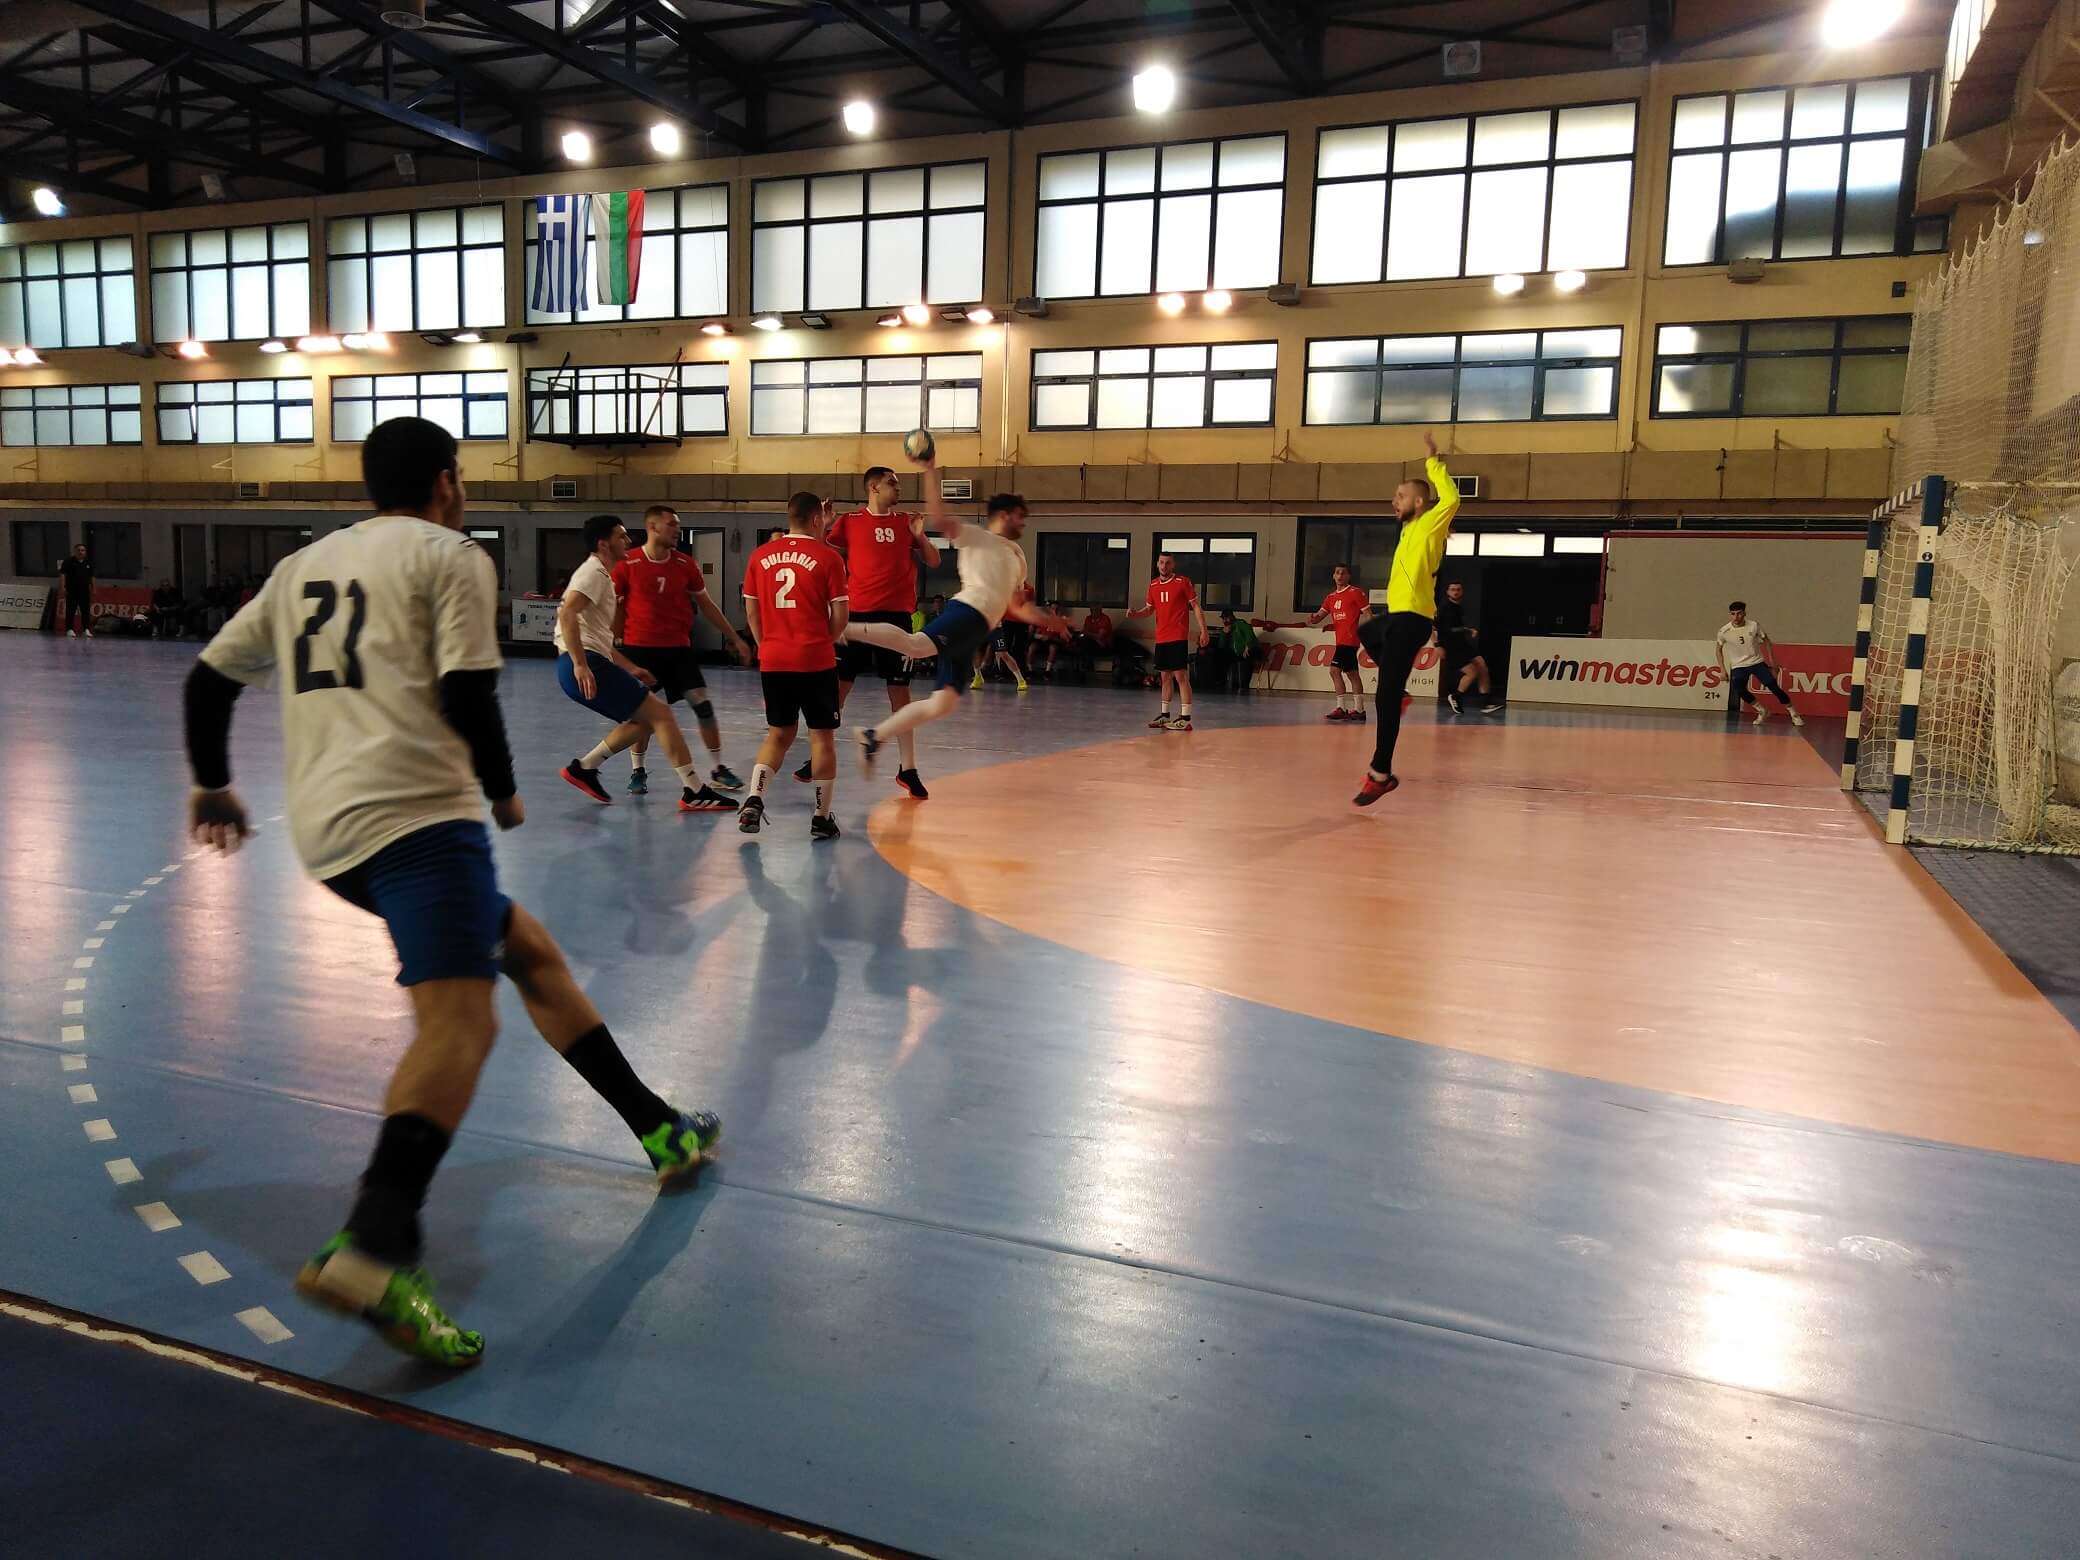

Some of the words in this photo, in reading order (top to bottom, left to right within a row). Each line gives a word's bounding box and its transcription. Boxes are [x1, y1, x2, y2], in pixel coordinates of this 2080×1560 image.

[875, 527, 895, 543] 89
[760, 551, 818, 572] BULGARIA
[657, 576, 666, 593] 7
[775, 567, 797, 609] 2
[1160, 591, 1169, 603] 11
[75, 602, 150, 618] ORRIS
[294, 579, 366, 694] 21
[1739, 636, 1745, 645] 3
[1519, 654, 1722, 689] winmasters
[1410, 678, 1435, 686] HIGH
[1704, 691, 1721, 700] 21+
